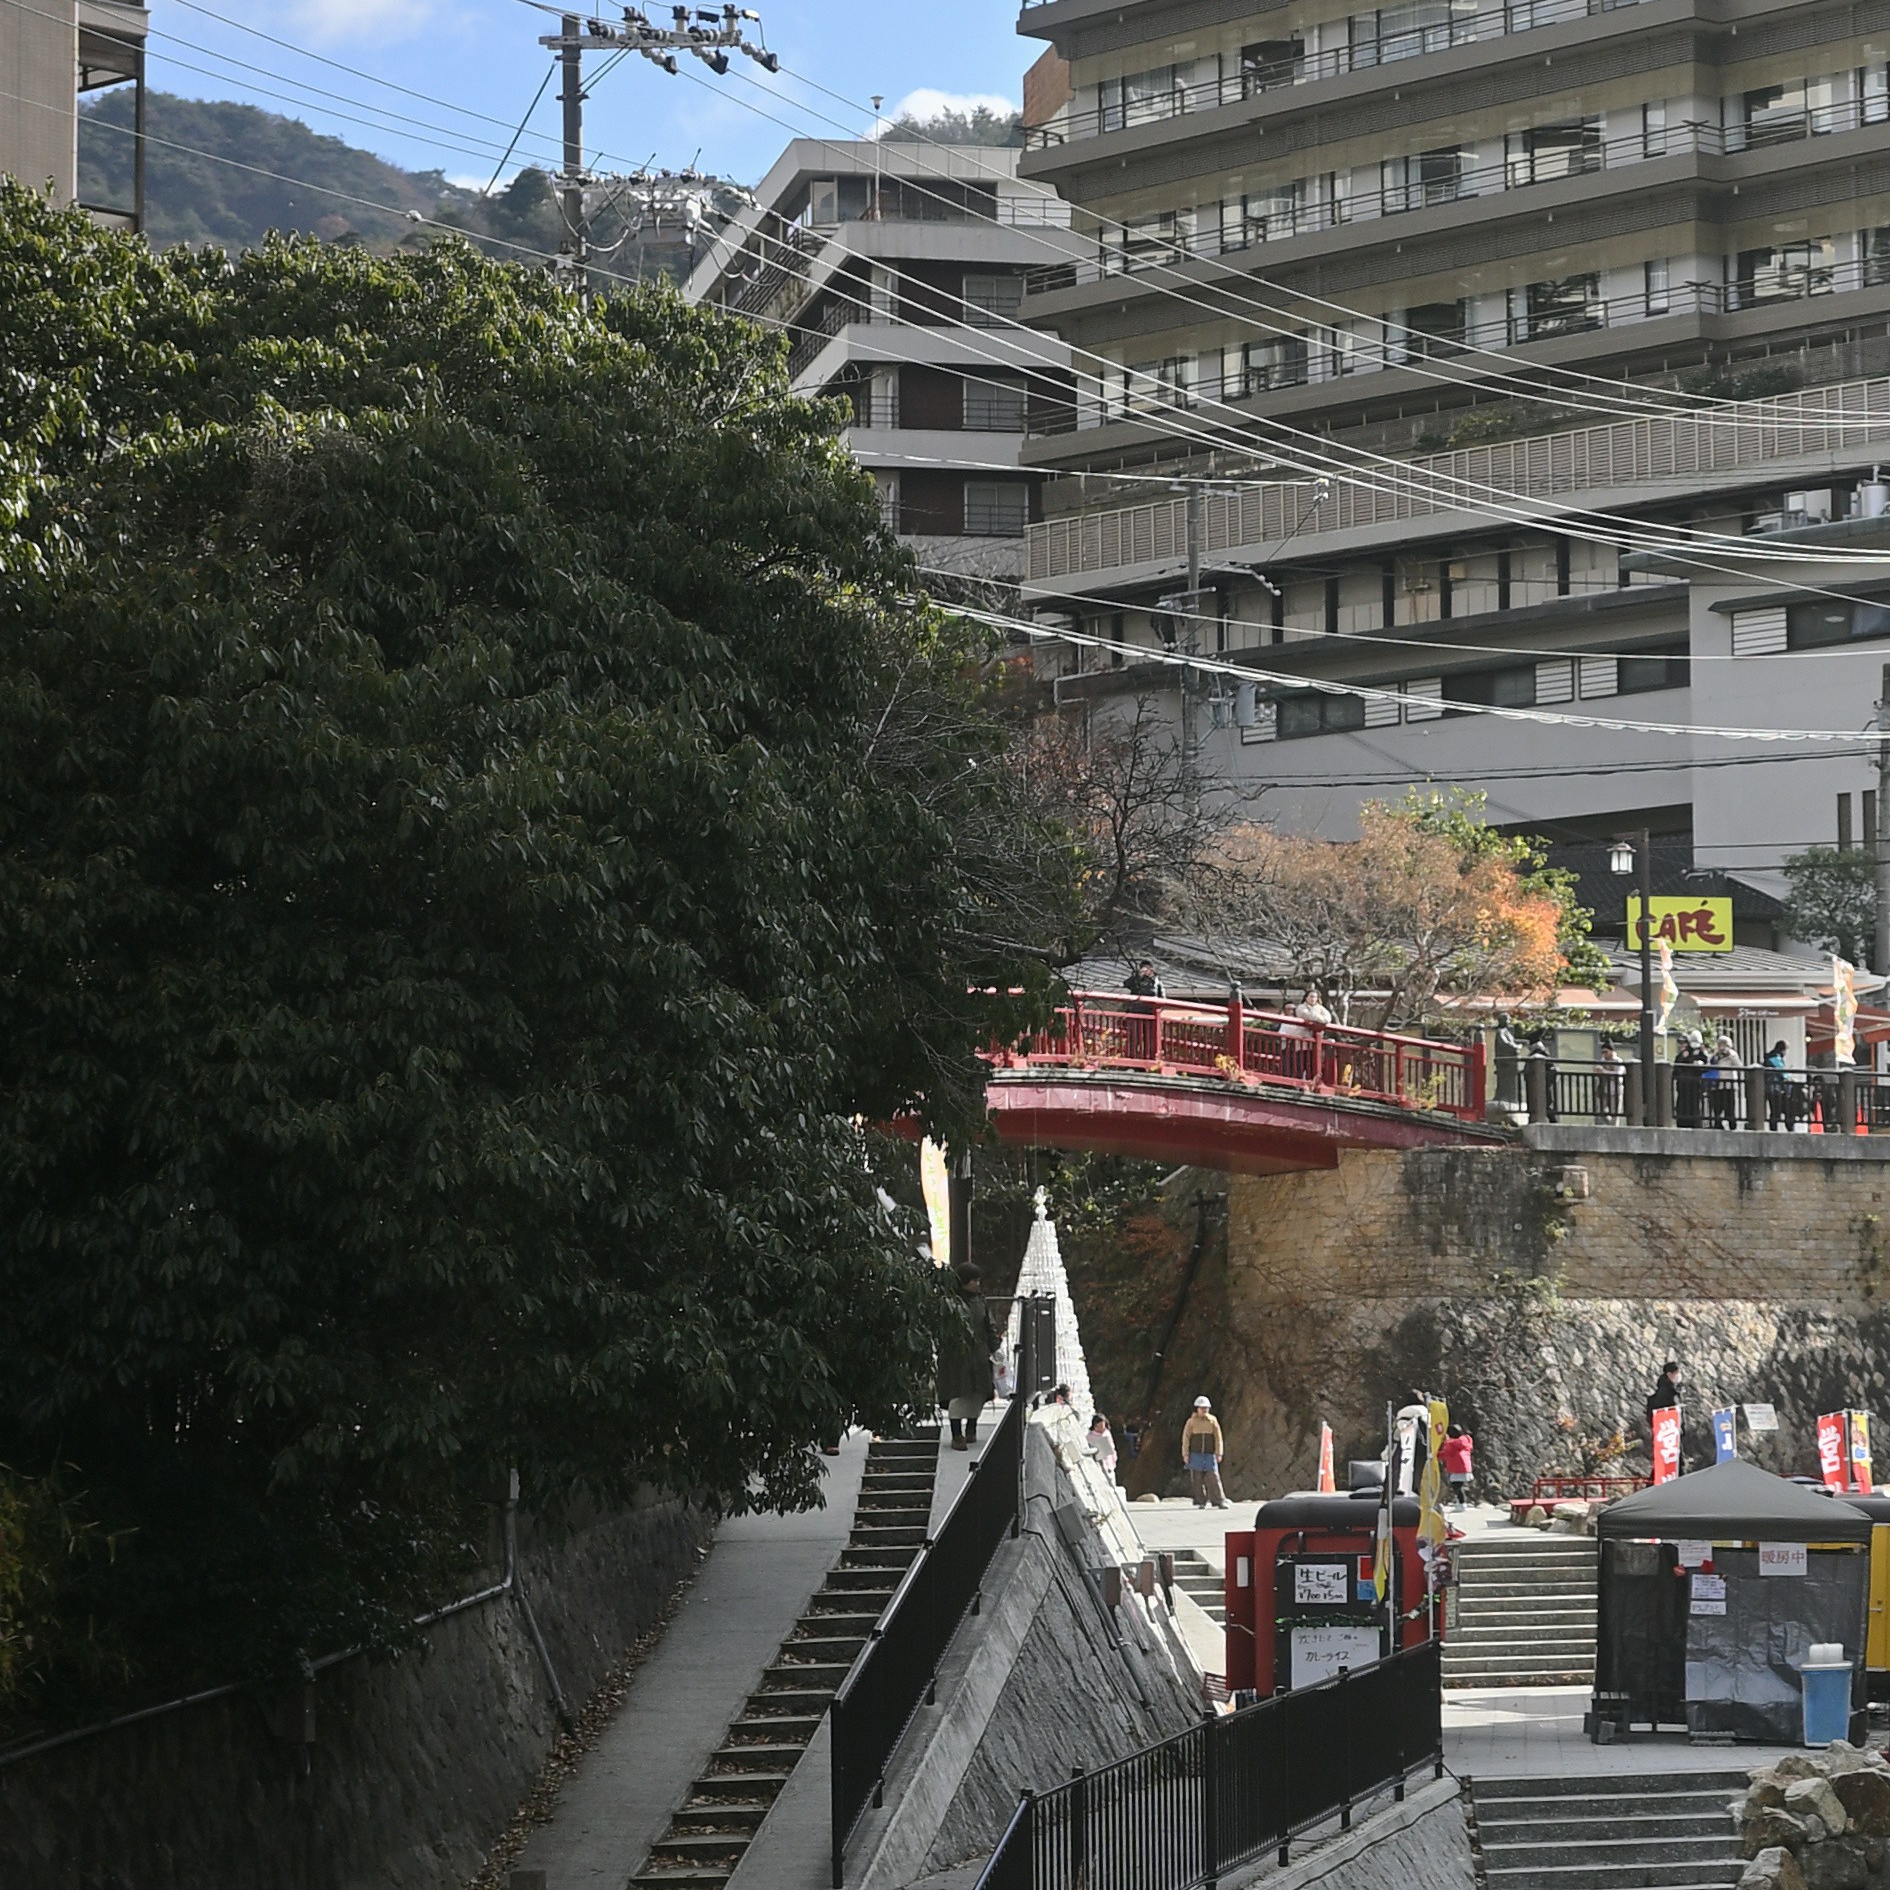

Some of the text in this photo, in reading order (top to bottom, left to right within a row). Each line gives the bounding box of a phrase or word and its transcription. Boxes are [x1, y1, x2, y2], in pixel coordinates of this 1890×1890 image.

[1761, 1550, 1804, 1565] 暖房中
[1300, 1568, 1347, 1583] 生ビール
[1305, 1651, 1350, 1662] カレーライス
